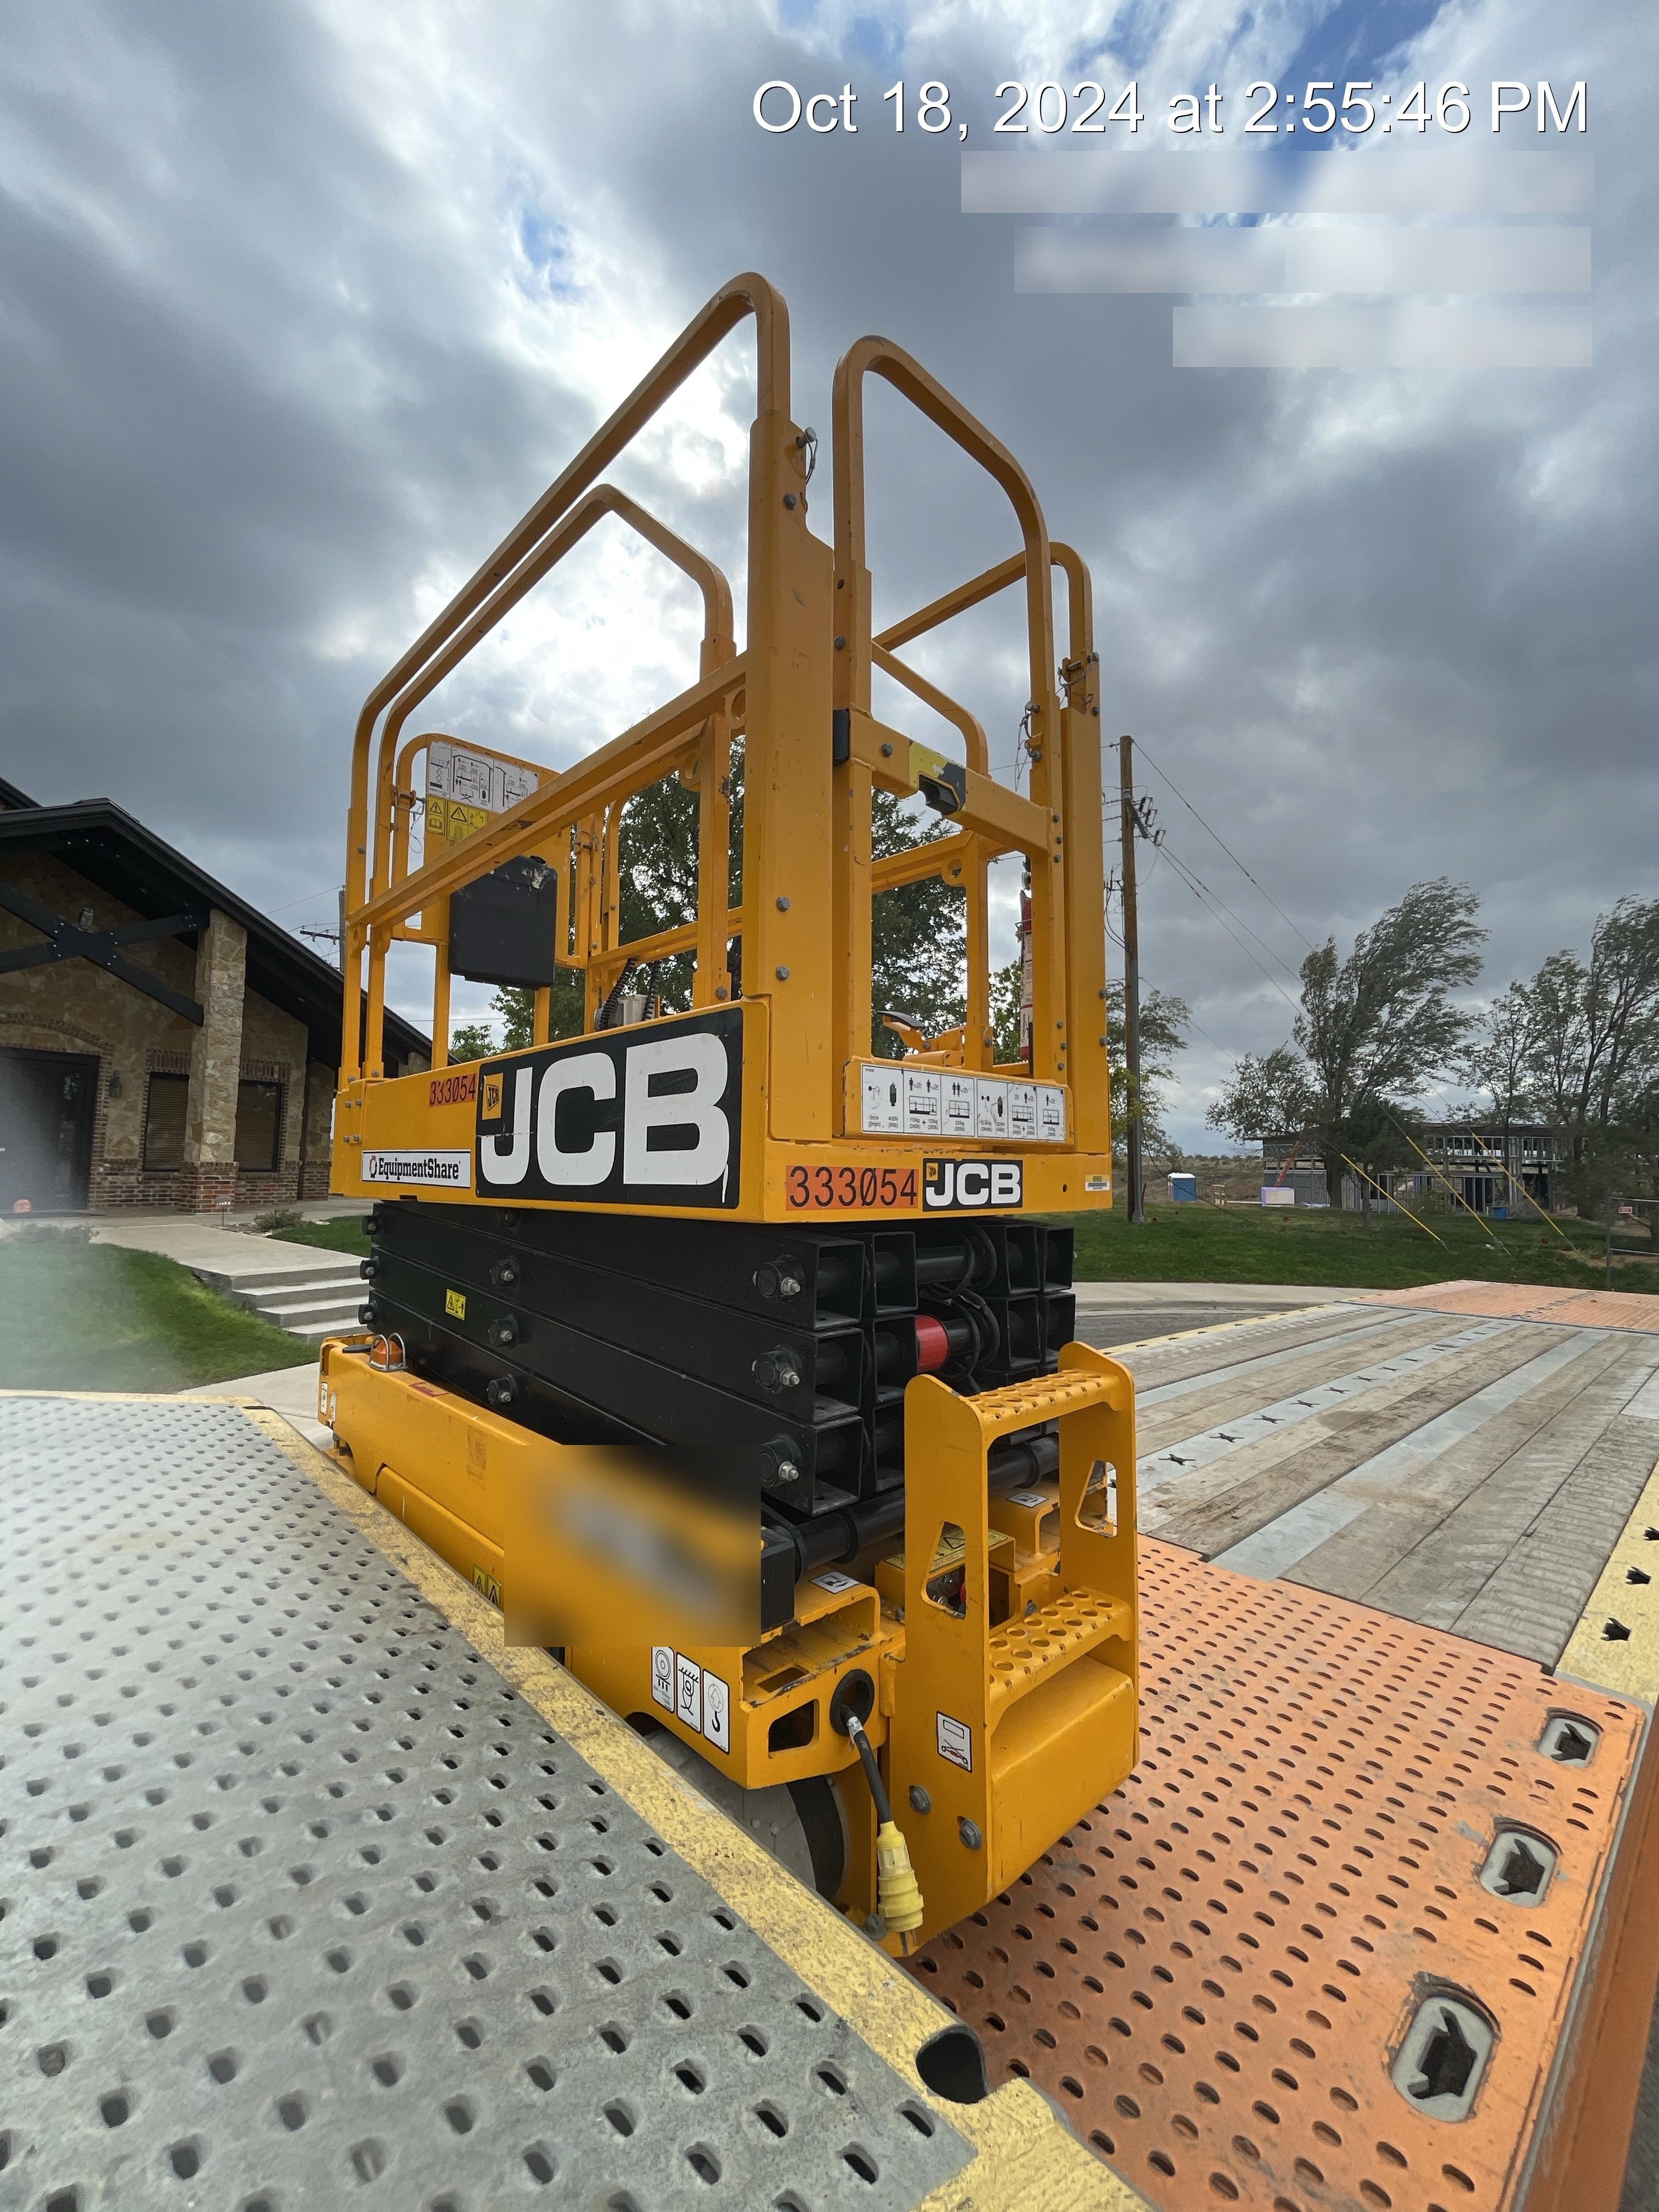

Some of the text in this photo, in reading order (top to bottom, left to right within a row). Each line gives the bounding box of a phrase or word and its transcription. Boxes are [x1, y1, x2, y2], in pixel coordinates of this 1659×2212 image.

[430, 1073, 476, 1105] 333054
[488, 1086, 500, 1108] JCB
[481, 1032, 730, 1186] JCB
[378, 1158, 460, 1181] EquipmentShare
[789, 1166, 917, 1207] 333054
[926, 1163, 1021, 1206] JCB
